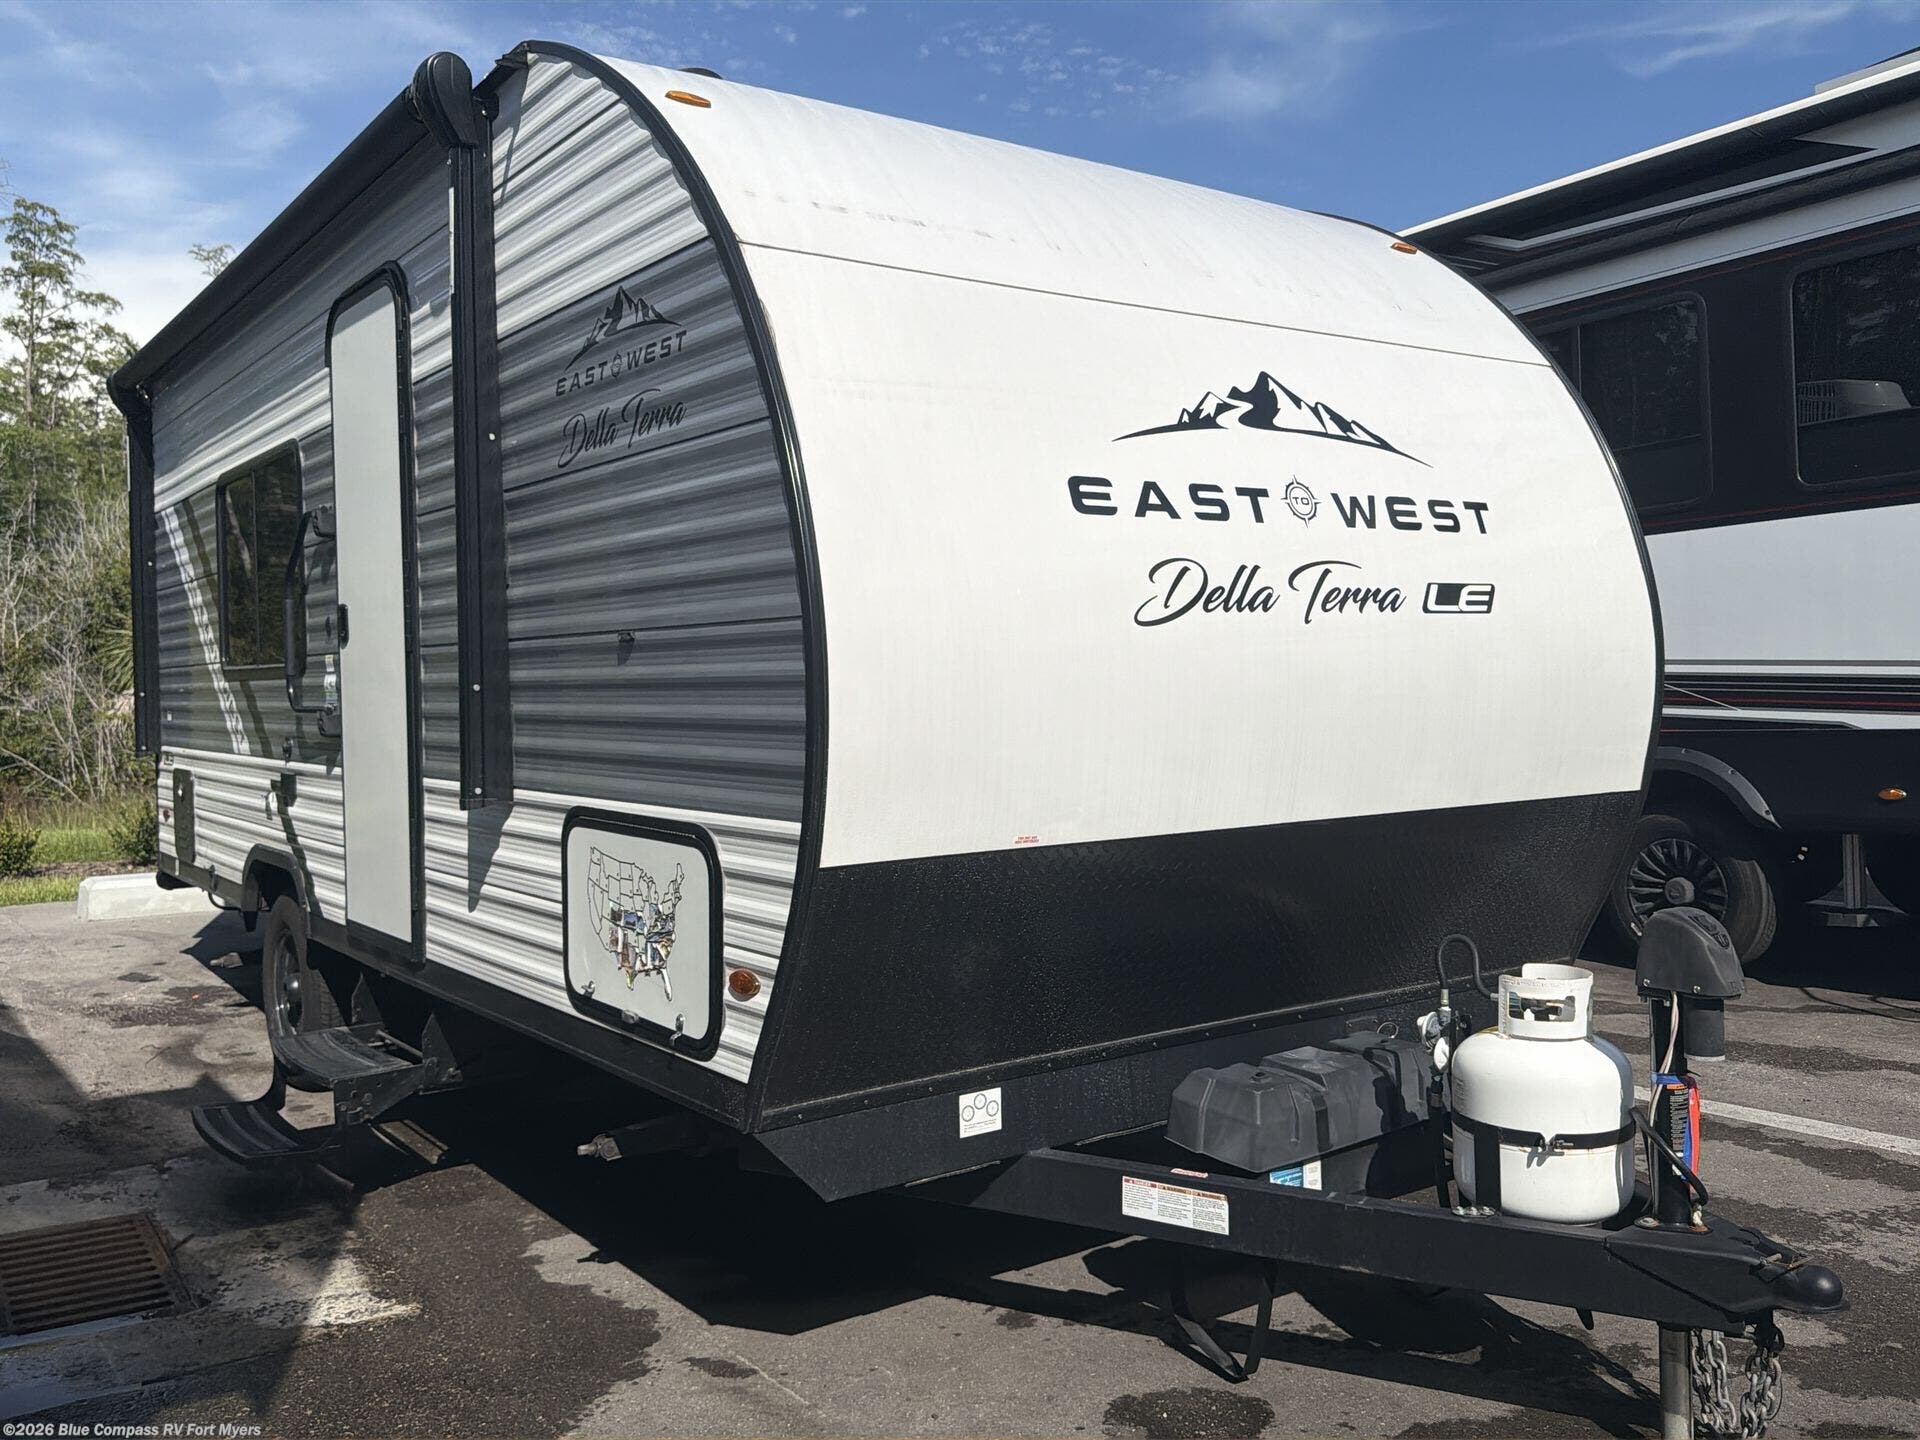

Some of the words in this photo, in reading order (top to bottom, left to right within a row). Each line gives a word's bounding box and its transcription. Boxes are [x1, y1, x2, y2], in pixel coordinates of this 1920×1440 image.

[556, 361, 608, 397] EAST
[627, 330, 687, 371] WEST
[558, 407, 619, 468] Della
[622, 388, 687, 448] Terra
[1067, 475, 1270, 524] EAST
[1292, 496, 1310, 505] TO
[1330, 492, 1490, 534] WEST
[1134, 557, 1280, 627] Della
[1288, 560, 1406, 624] Terra
[1425, 583, 1495, 613] LE
